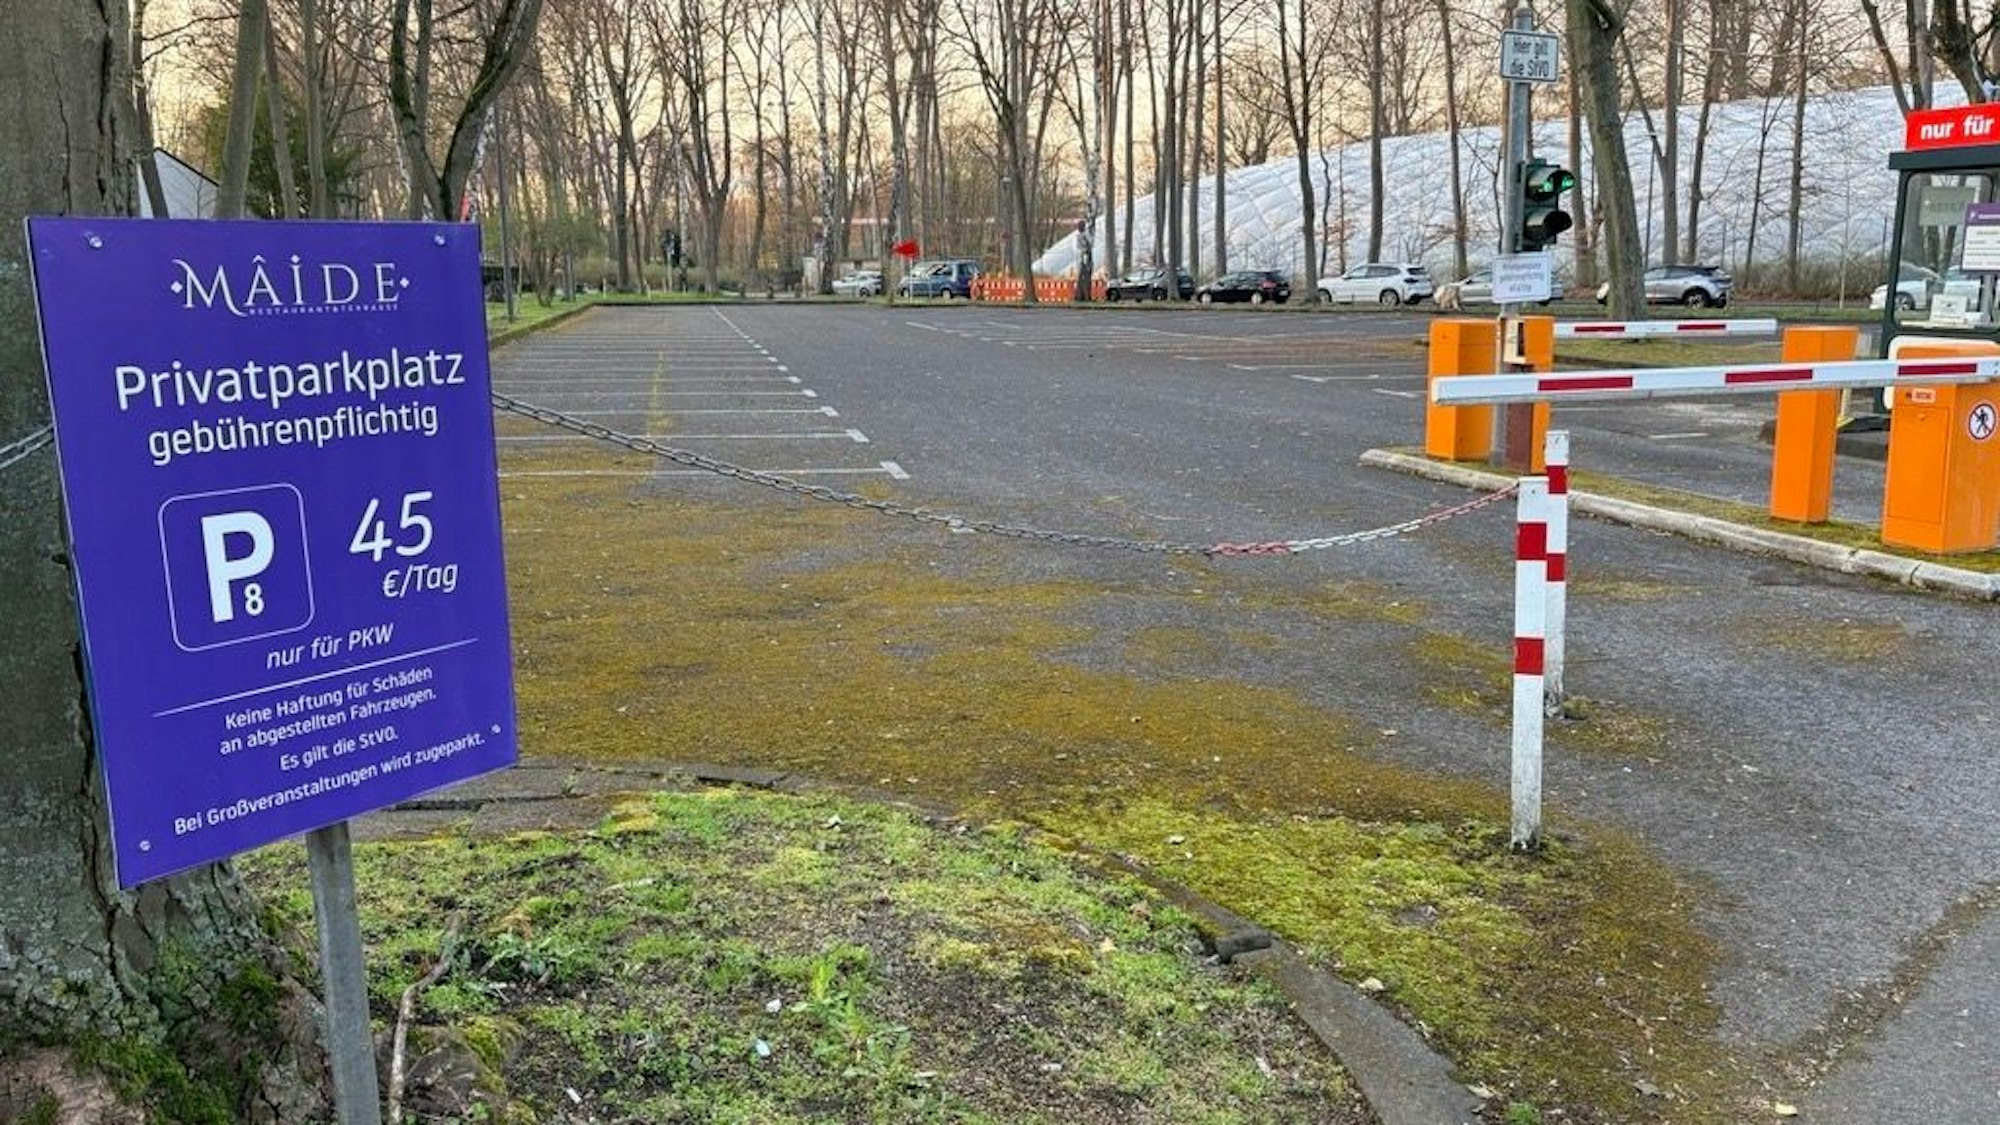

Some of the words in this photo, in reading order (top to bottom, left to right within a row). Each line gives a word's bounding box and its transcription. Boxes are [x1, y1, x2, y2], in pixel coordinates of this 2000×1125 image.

[1921, 121, 1954, 140] nur
[1963, 115, 1995, 137] für
[115, 348, 466, 410] Privatparkplatz
[149, 401, 439, 466] gebührenpflichtig
[349, 491, 433, 562] 45
[382, 562, 459, 599] €/Tag
[266, 645, 302, 669] nur
[311, 635, 341, 660] für
[348, 623, 394, 650] PKW
[220, 740, 242, 755] an
[247, 711, 347, 748] abgestellten
[350, 687, 437, 720] Fahrzeugen.
[225, 707, 272, 730] Keine
[276, 690, 344, 718] Haftung
[347, 681, 369, 701] für
[373, 666, 433, 693] Schäden
[280, 754, 300, 771] Es
[303, 746, 330, 768] gilt
[333, 736, 355, 756] die
[358, 725, 399, 750] StVO.
[174, 813, 202, 835] Bei
[206, 764, 379, 826] Großveranstaltungen
[381, 751, 411, 773] wird
[415, 732, 486, 765] zugeparkt.
